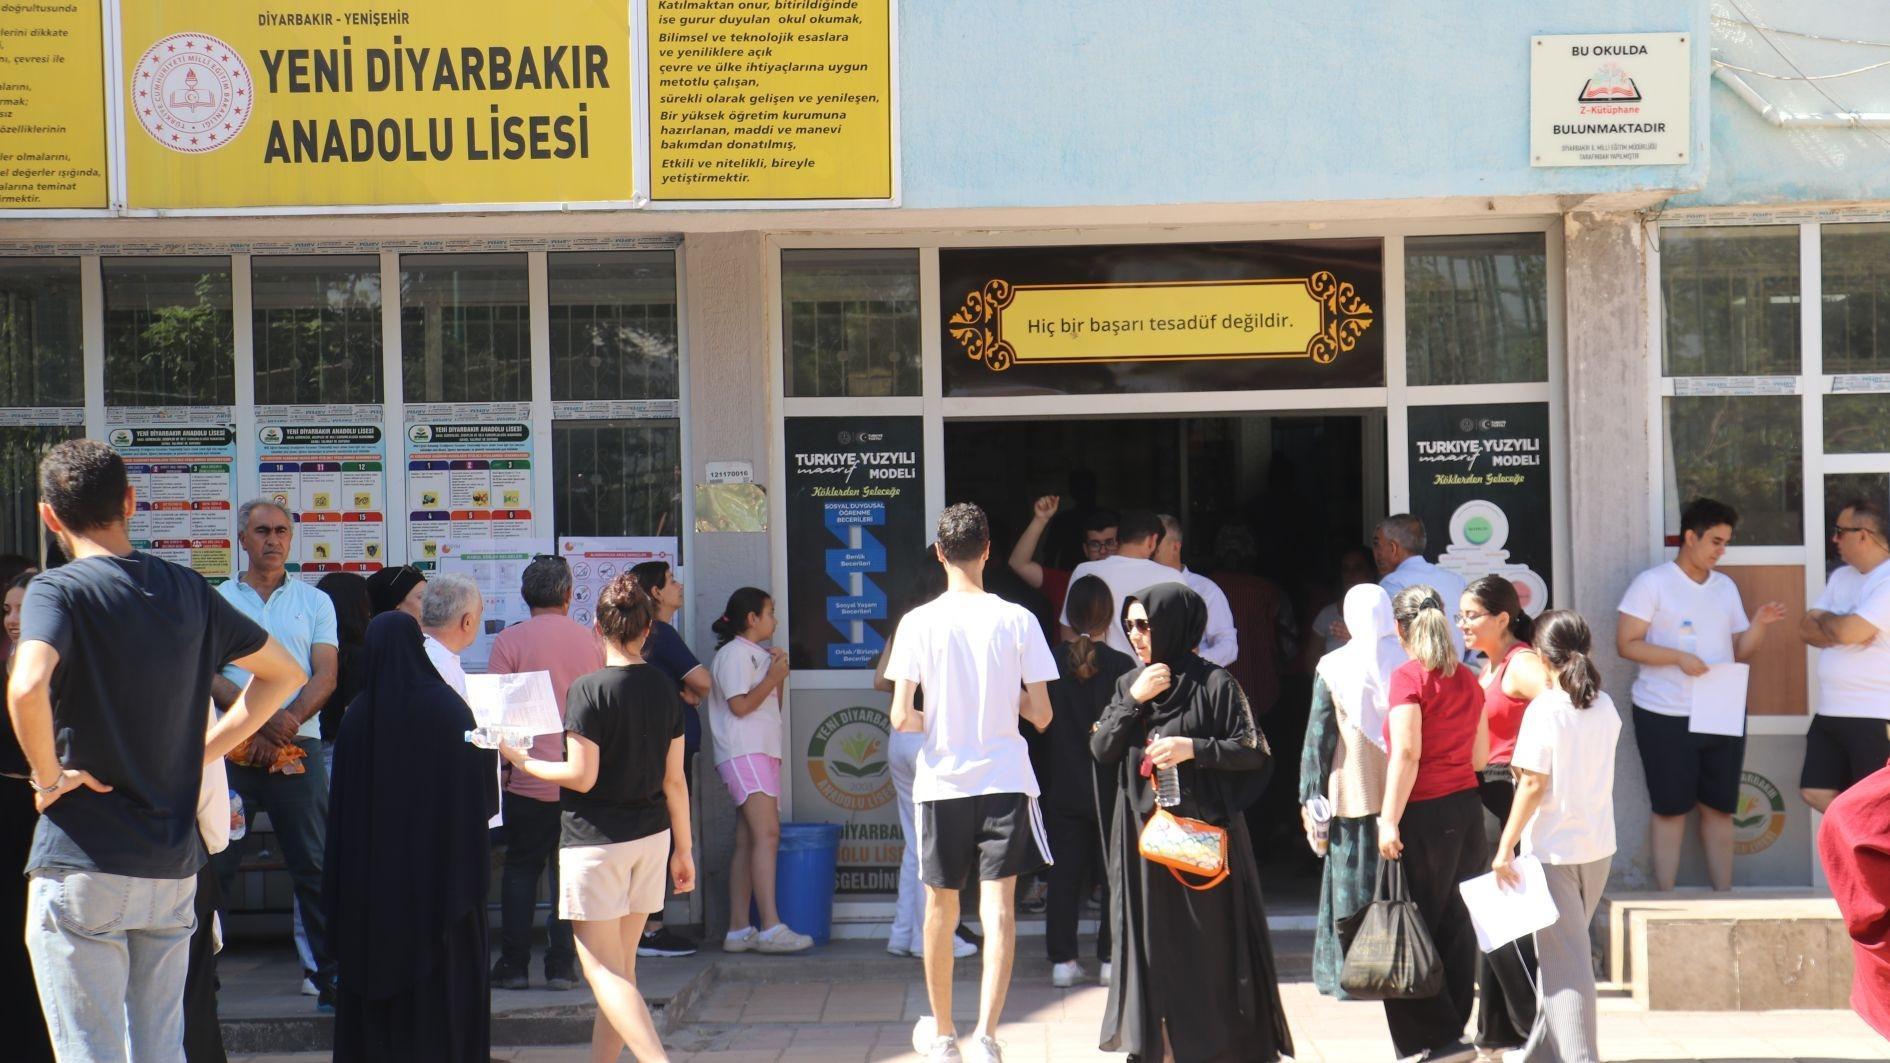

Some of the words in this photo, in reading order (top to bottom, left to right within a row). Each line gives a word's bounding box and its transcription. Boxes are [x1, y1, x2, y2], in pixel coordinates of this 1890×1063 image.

[2, 4, 77, 13] doğrultusunda
[658, 0, 734, 9] Katılmaktan
[738, 2, 770, 10] onur,
[775, 0, 858, 11] bitirildiğinde
[258, 10, 333, 26] DİYARBAKIR
[344, 9, 410, 27] YENİŞEHİR
[659, 15, 675, 24] ise
[680, 16, 715, 26] gurur
[720, 15, 770, 26] duyulan
[779, 14, 805, 24] okul
[810, 14, 862, 25] okumak,
[659, 33, 707, 42] Bilimsel
[731, 33, 793, 44] teknolojik
[798, 33, 849, 42] esaslara
[678, 48, 743, 59] yeniliklere
[748, 48, 772, 59] açık
[1572, 46, 1588, 56] BU
[1593, 45, 1648, 55] OKULDA
[14, 55, 49, 65] çevresi
[53, 55, 64, 63] ile
[260, 36, 354, 94] YENİ
[367, 35, 610, 92] DİYARBAKIR
[660, 64, 693, 74] çevre
[716, 62, 741, 71] ülke
[746, 62, 824, 73] ihtiyaçlarına
[829, 63, 868, 73] uygun
[660, 78, 709, 87] metotlu
[714, 77, 759, 89] çalışan,
[661, 94, 702, 103] sürekli
[707, 93, 745, 103] olarak
[750, 93, 794, 105] gelişen
[817, 93, 879, 104] yenileşen,
[661, 111, 678, 120] Bir
[681, 111, 725, 122] yüksek
[729, 111, 778, 122] öğretim
[783, 111, 847, 120] kurumuna
[1580, 106, 1640, 115] Z-Kütüphane
[264, 118, 454, 164] ANADOLU
[466, 102, 590, 161] LİSESİ
[661, 125, 730, 136] hazırlanan,
[734, 125, 773, 134] maddi
[778, 126, 792, 134] ve
[796, 124, 842, 134] manevi
[1553, 123, 1665, 135] BULUNMAKTADIR
[661, 140, 722, 150] bakımdan
[727, 140, 796, 151] donatılmış,
[662, 159, 694, 168] Etkili
[716, 158, 767, 169] nitelikli,
[772, 158, 815, 170] bireyle
[661, 173, 750, 185] yetiştirmektir.
[1028, 319, 1055, 338] Hiç
[1060, 317, 1084, 334] bir
[1090, 316, 1144, 336] başarı
[1149, 314, 1217, 332] tesadüf
[1221, 313, 1294, 331] değildir.
[1492, 455, 1540, 466] MODELİ
[869, 468, 915, 479] MODELİ
[1433, 474, 1483, 485] Köklerden
[1486, 473, 1524, 485] Geleceğe
[811, 487, 861, 497] Köklerden
[862, 487, 901, 498] Geleceğe
[838, 509, 871, 517] ÖĞRENME
[816, 716, 839, 741] YENİ
[840, 820, 904, 840] İYARBA
[837, 845, 869, 864] OLU
